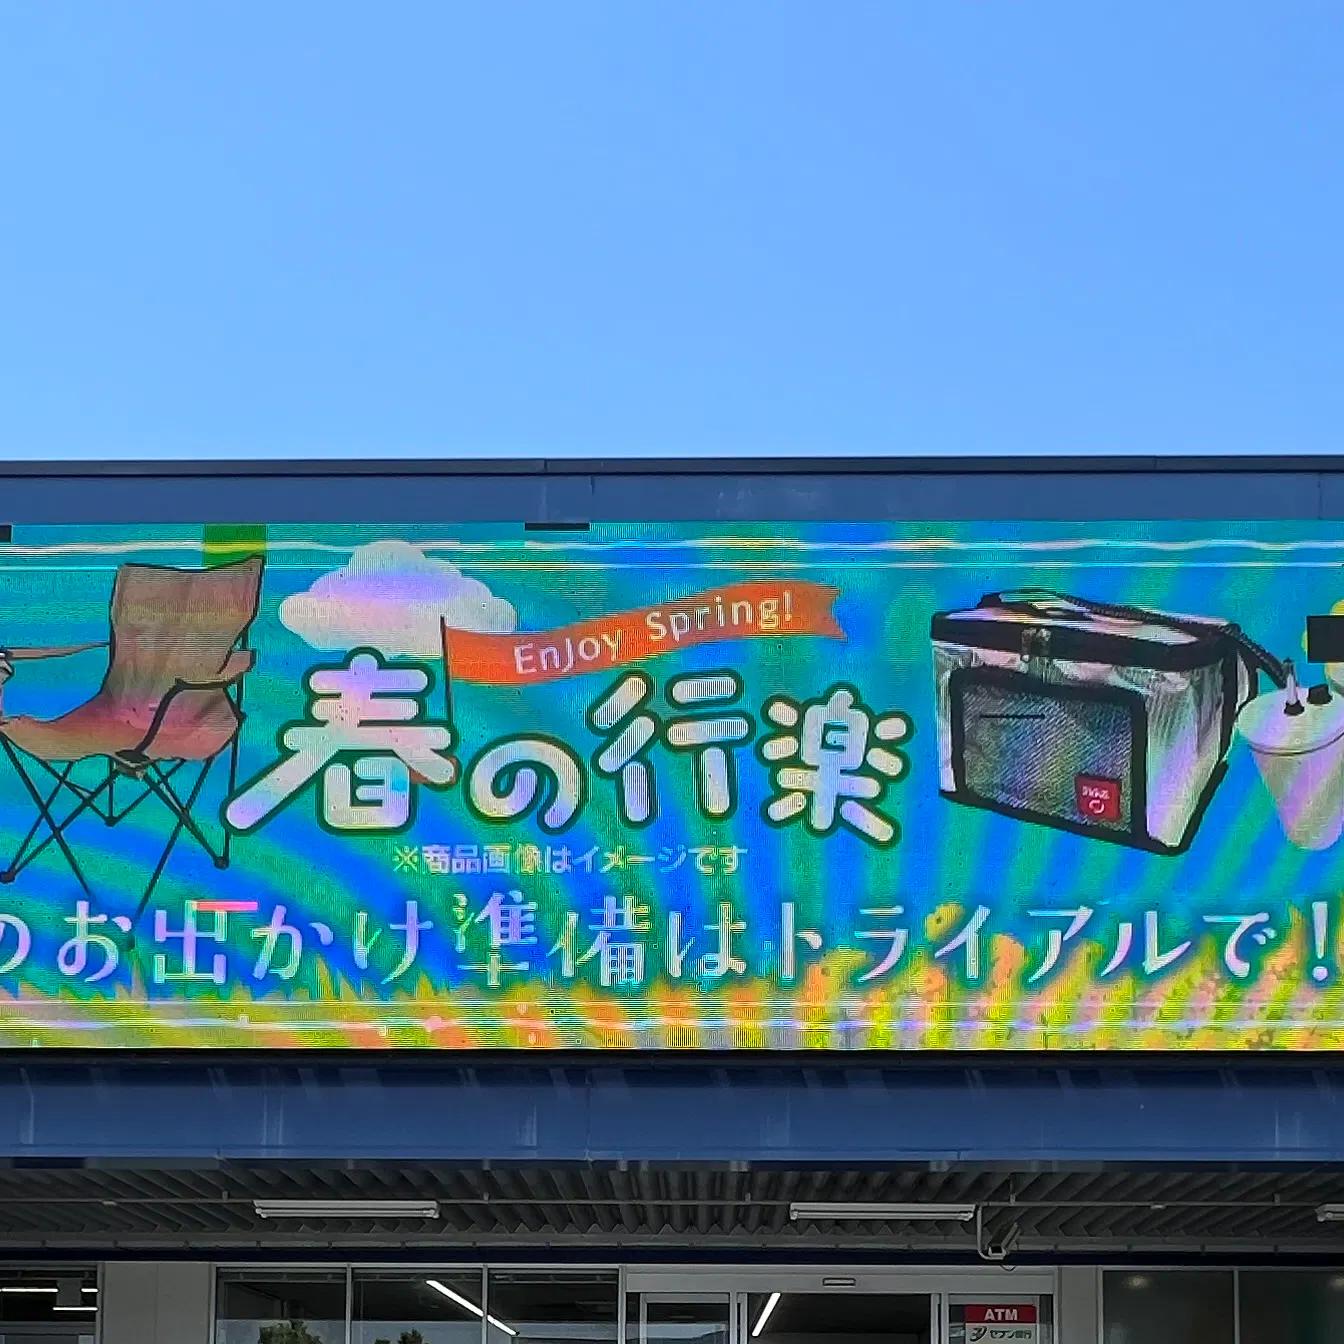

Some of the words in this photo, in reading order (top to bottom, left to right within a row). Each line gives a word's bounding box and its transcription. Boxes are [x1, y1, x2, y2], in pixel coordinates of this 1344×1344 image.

[644, 590, 792, 642] Spring!
[225, 650, 912, 845] 春の行楽
[984, 1308, 1018, 1321] ATM
